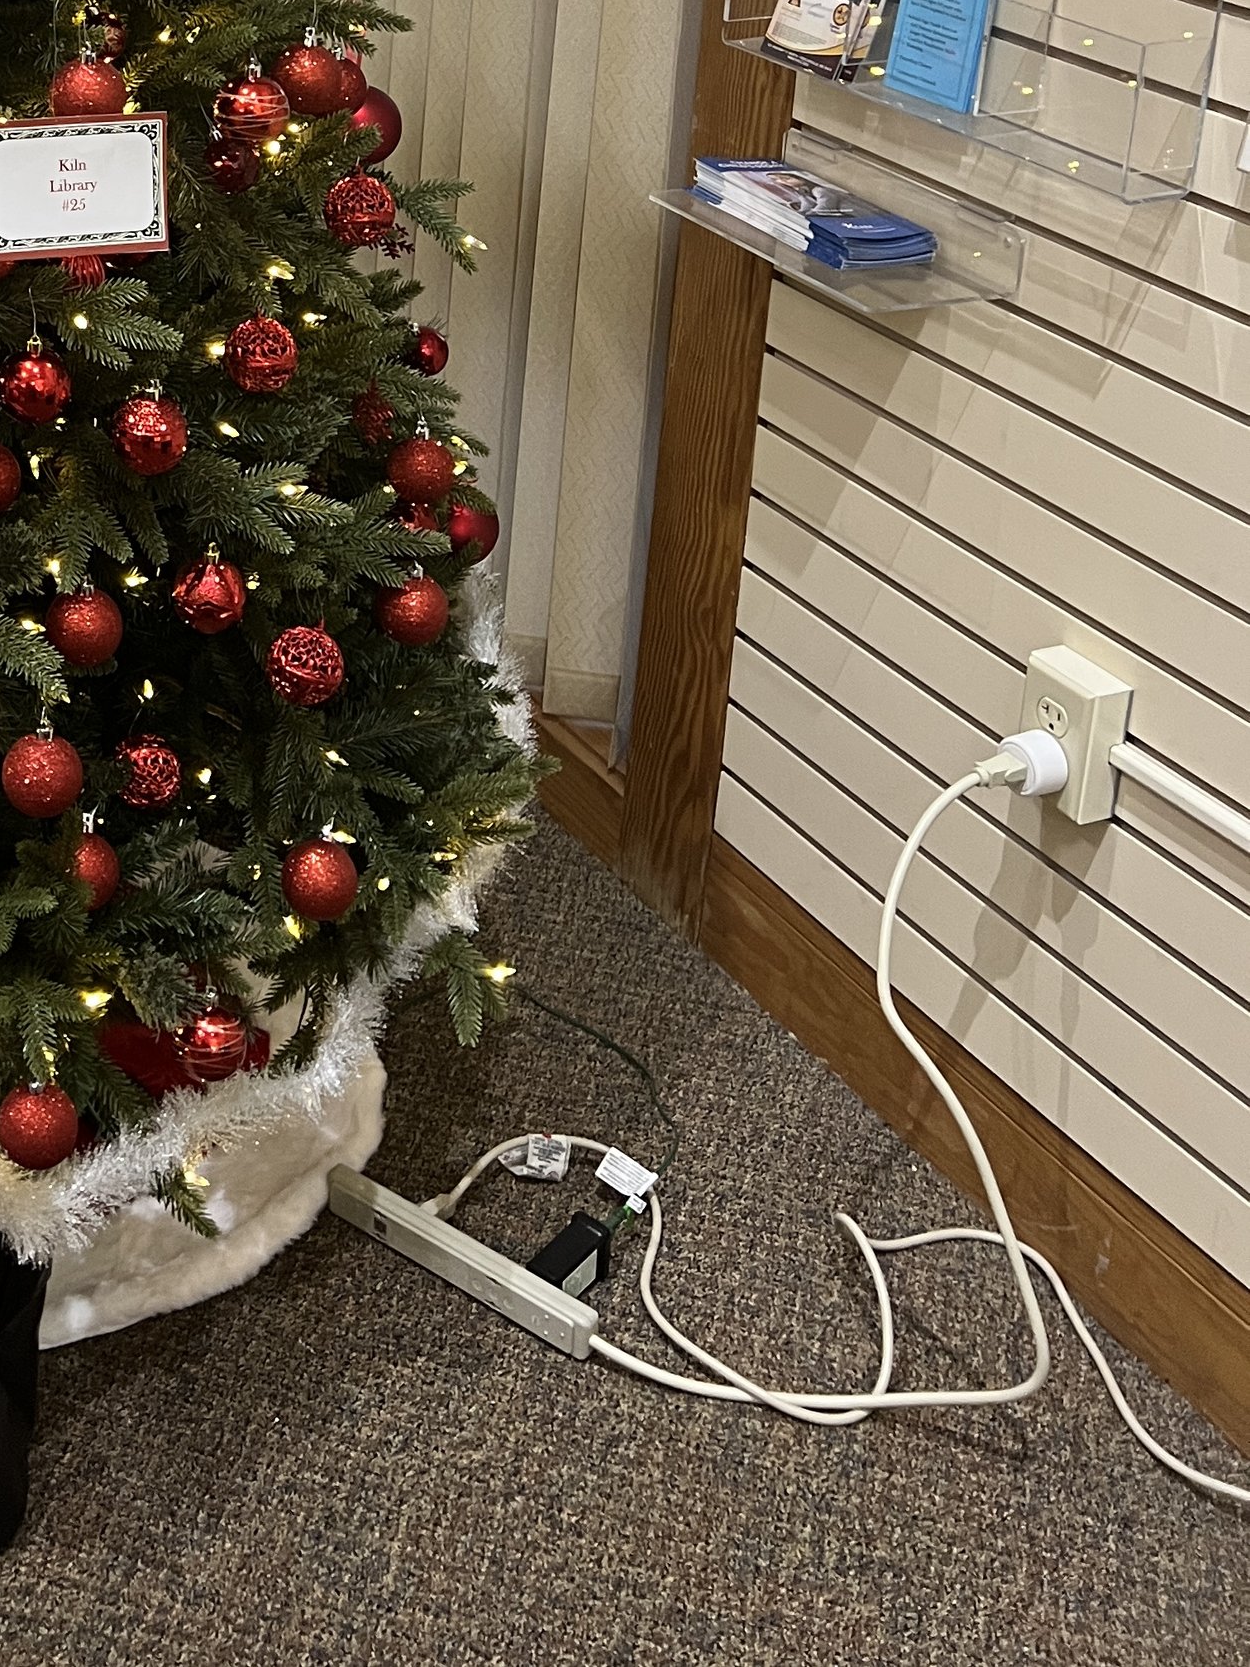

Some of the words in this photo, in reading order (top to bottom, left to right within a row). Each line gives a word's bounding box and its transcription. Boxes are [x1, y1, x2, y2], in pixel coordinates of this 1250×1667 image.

[58, 159, 87, 173] Kiln
[49, 179, 98, 193] Library
[61, 198, 87, 212] #25
